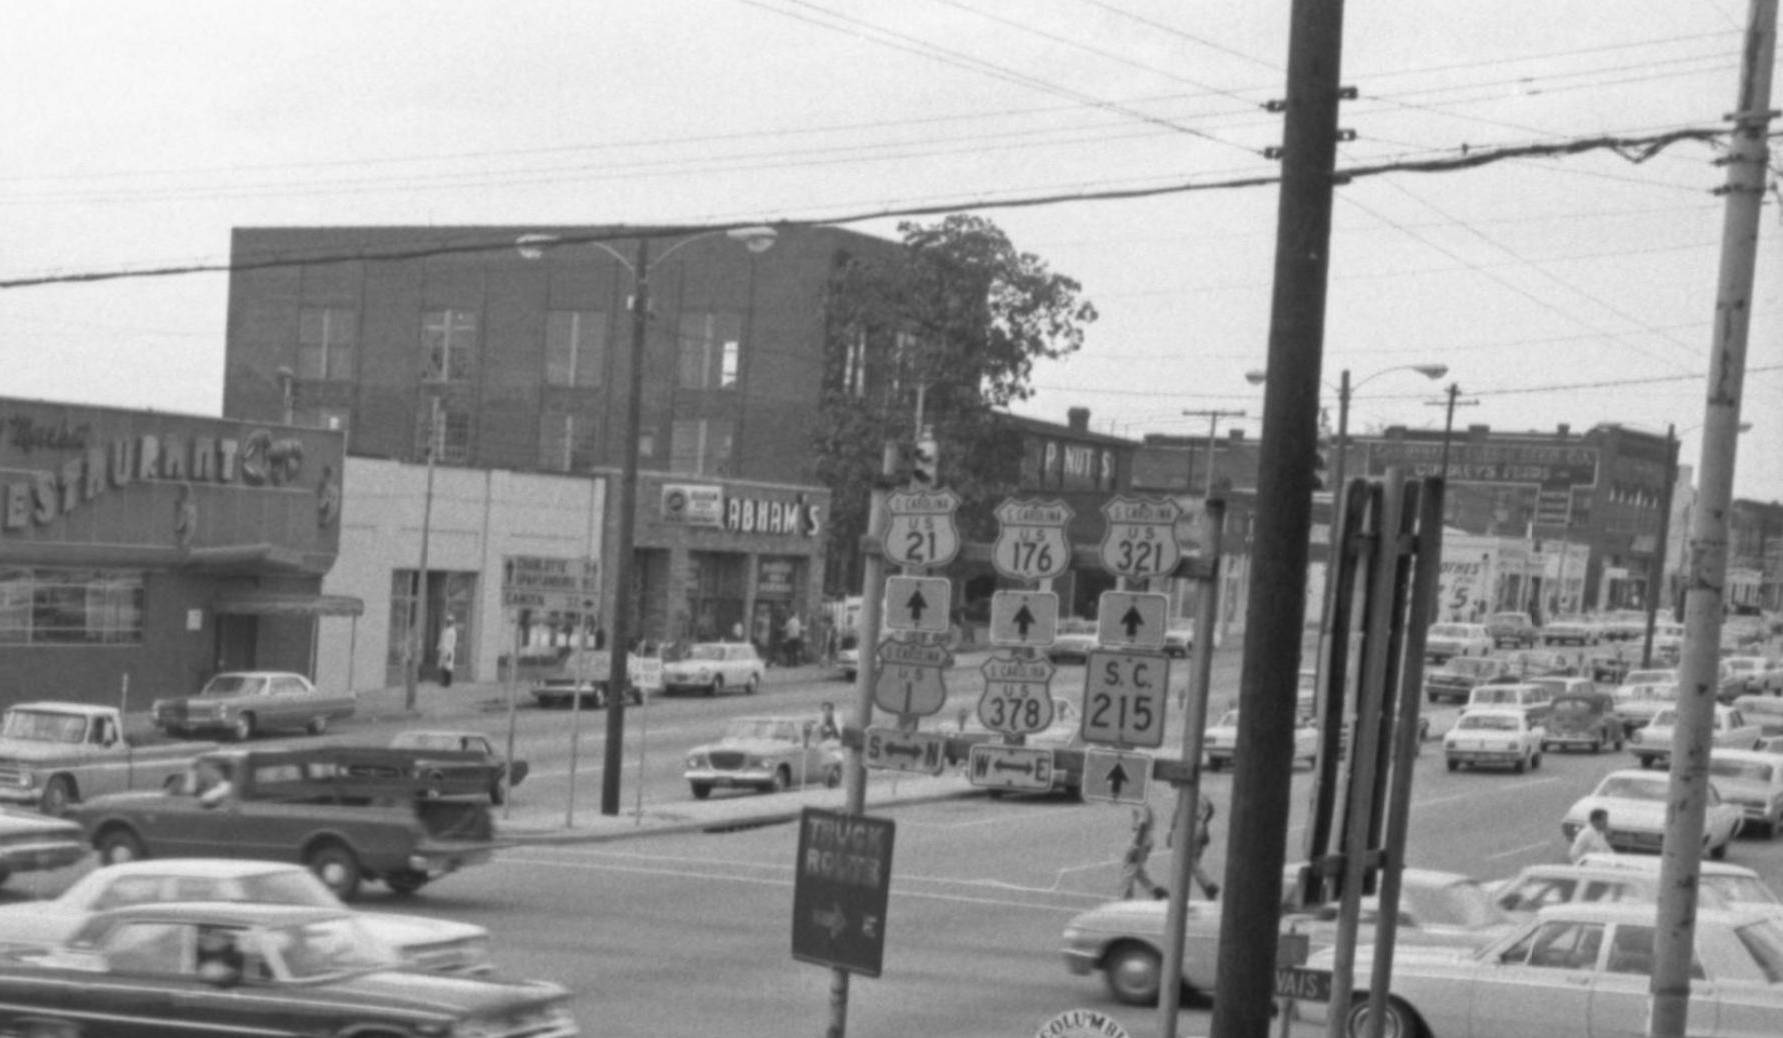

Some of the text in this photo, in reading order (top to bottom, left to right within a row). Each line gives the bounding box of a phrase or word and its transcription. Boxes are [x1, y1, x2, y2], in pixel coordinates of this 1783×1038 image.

[728, 494, 820, 537] ABHAM'S
[907, 531, 936, 562] 21
[1013, 542, 1053, 572] 176
[1118, 540, 1162, 572] 321
[903, 681, 913, 713] 1
[1090, 693, 1153, 731] 215
[989, 698, 1040, 731] 378
[868, 735, 940, 767] S N
[974, 753, 1048, 782] W E
[808, 817, 886, 851] TRUCK
[805, 848, 881, 888] ROUTE
[1277, 970, 1318, 998] VAIS
